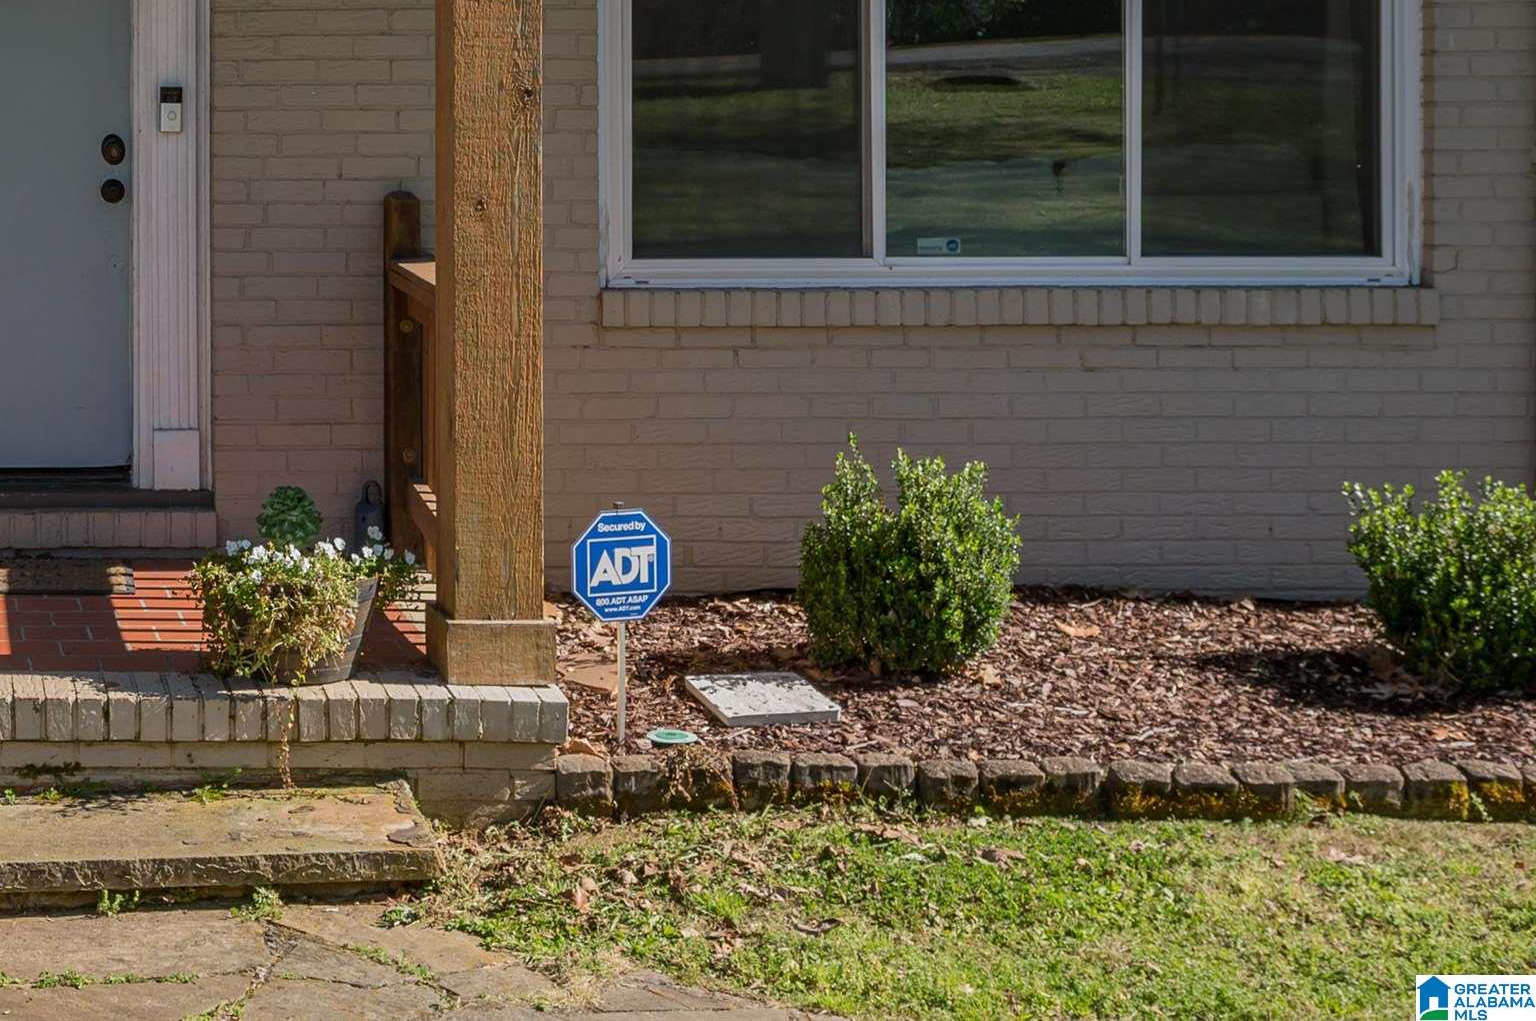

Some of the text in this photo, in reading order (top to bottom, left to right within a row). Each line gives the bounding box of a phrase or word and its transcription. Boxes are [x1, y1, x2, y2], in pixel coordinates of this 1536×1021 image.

[597, 520, 646, 533] Secured by
[590, 545, 656, 587] ADT
